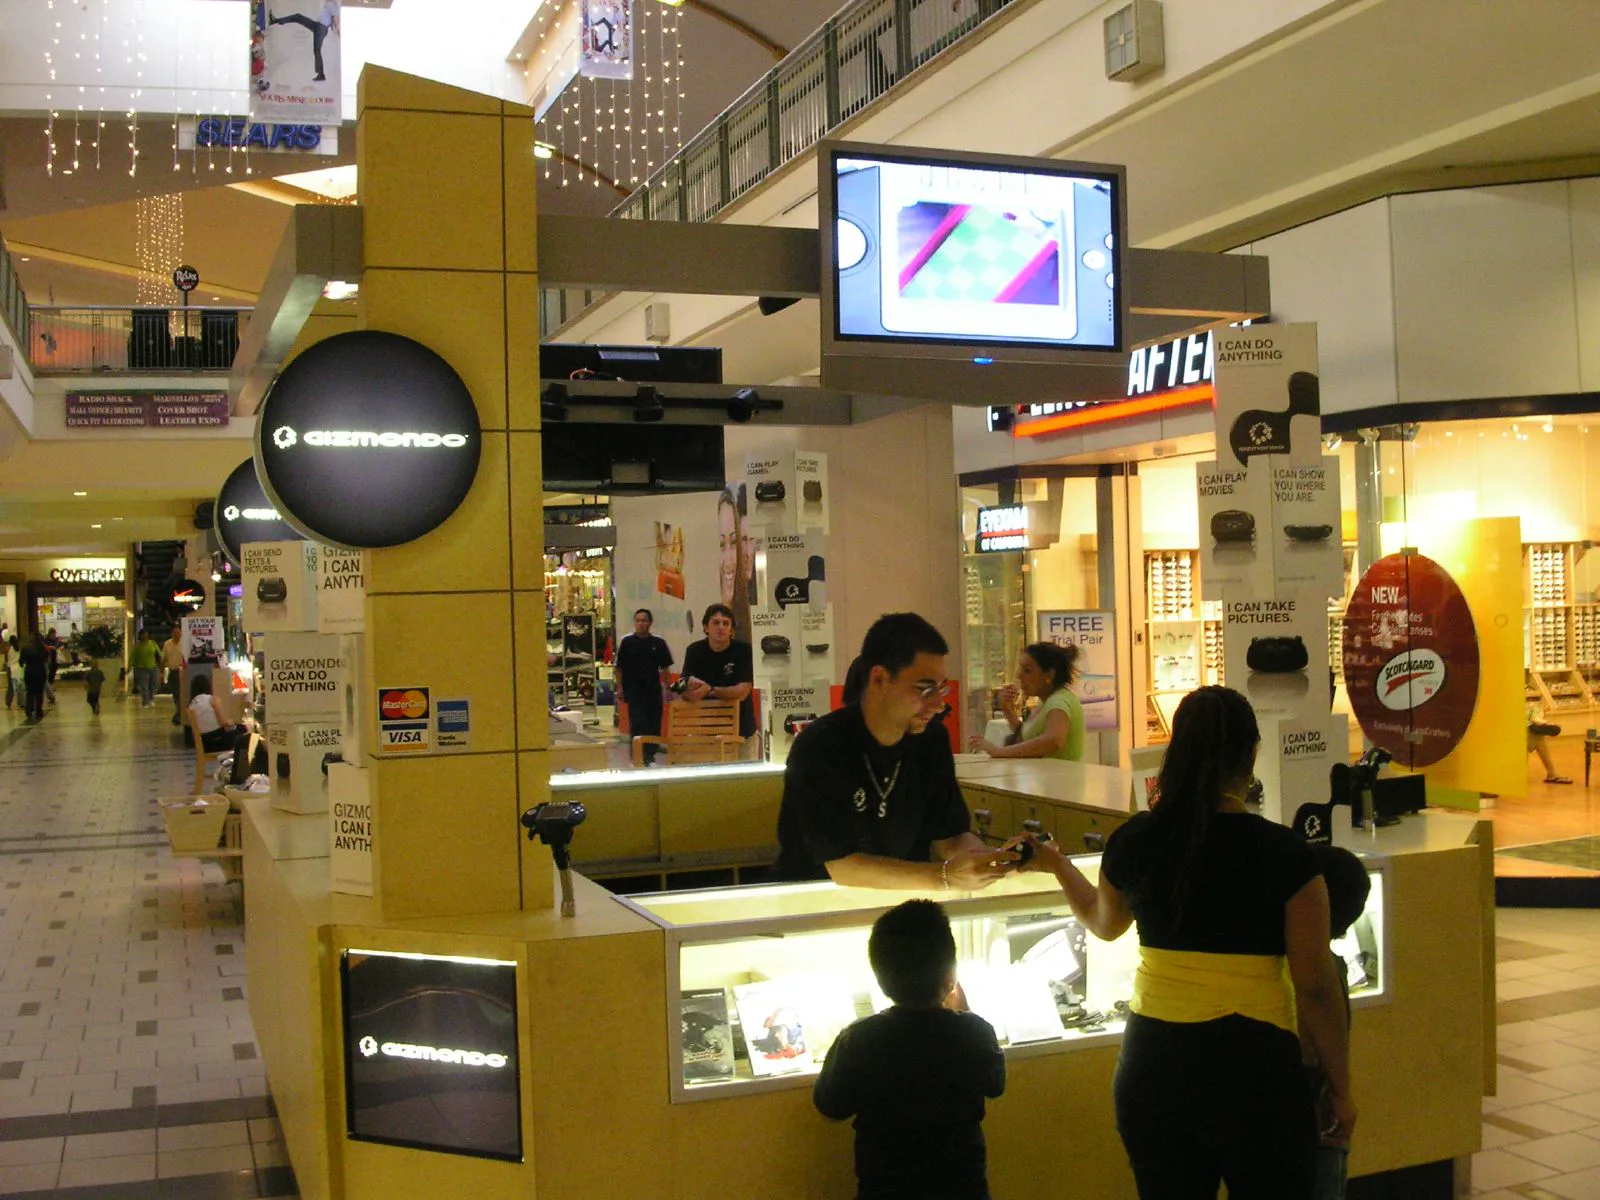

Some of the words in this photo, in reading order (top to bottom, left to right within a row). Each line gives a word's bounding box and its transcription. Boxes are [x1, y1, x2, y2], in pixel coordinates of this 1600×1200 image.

[197, 118, 322, 150] SEARS
[1218, 342, 1222, 350] I
[1225, 340, 1251, 350] CAN
[1255, 339, 1273, 349] DO
[1218, 350, 1282, 362] ANYTHING
[70, 406, 87, 414] MALL
[158, 406, 186, 414] COVER
[187, 406, 208, 414] SHOT
[160, 417, 196, 425] LEATHER
[198, 417, 220, 425] EXPO
[1204, 475, 1223, 486] CAN
[1225, 472, 1247, 483] PLAY
[1278, 470, 1297, 479] CAN
[1299, 470, 1325, 480] SHOW
[1200, 484, 1235, 496] MOVIES.
[1274, 480, 1294, 490] YOU
[1296, 481, 1326, 491] WHERE
[1275, 492, 1294, 502] YOU
[1296, 492, 1315, 502] ARE.
[248, 550, 262, 558] CAN
[264, 548, 282, 556] SEND
[244, 558, 265, 566] TEXTS
[324, 561, 327, 573] I
[331, 560, 360, 573] CAN
[1371, 586, 1400, 604] NEW
[1234, 602, 1260, 612] CAN
[1264, 602, 1296, 611] TAKE
[1049, 616, 1104, 632] FREE
[1228, 614, 1293, 624] PICTURES.
[1050, 634, 1075, 646] Trial
[1080, 634, 1104, 645] Pair
[271, 672, 274, 681] I
[278, 671, 304, 681] CAN
[308, 670, 327, 680] DO
[271, 682, 336, 692] ANYTHING
[309, 730, 328, 738] CAN
[389, 732, 422, 743] VISA
[1288, 734, 1306, 744] CAN
[1308, 731, 1320, 741] DO
[1284, 742, 1326, 756] ANYTHING
[335, 820, 338, 832] I
[341, 820, 364, 836] CAN
